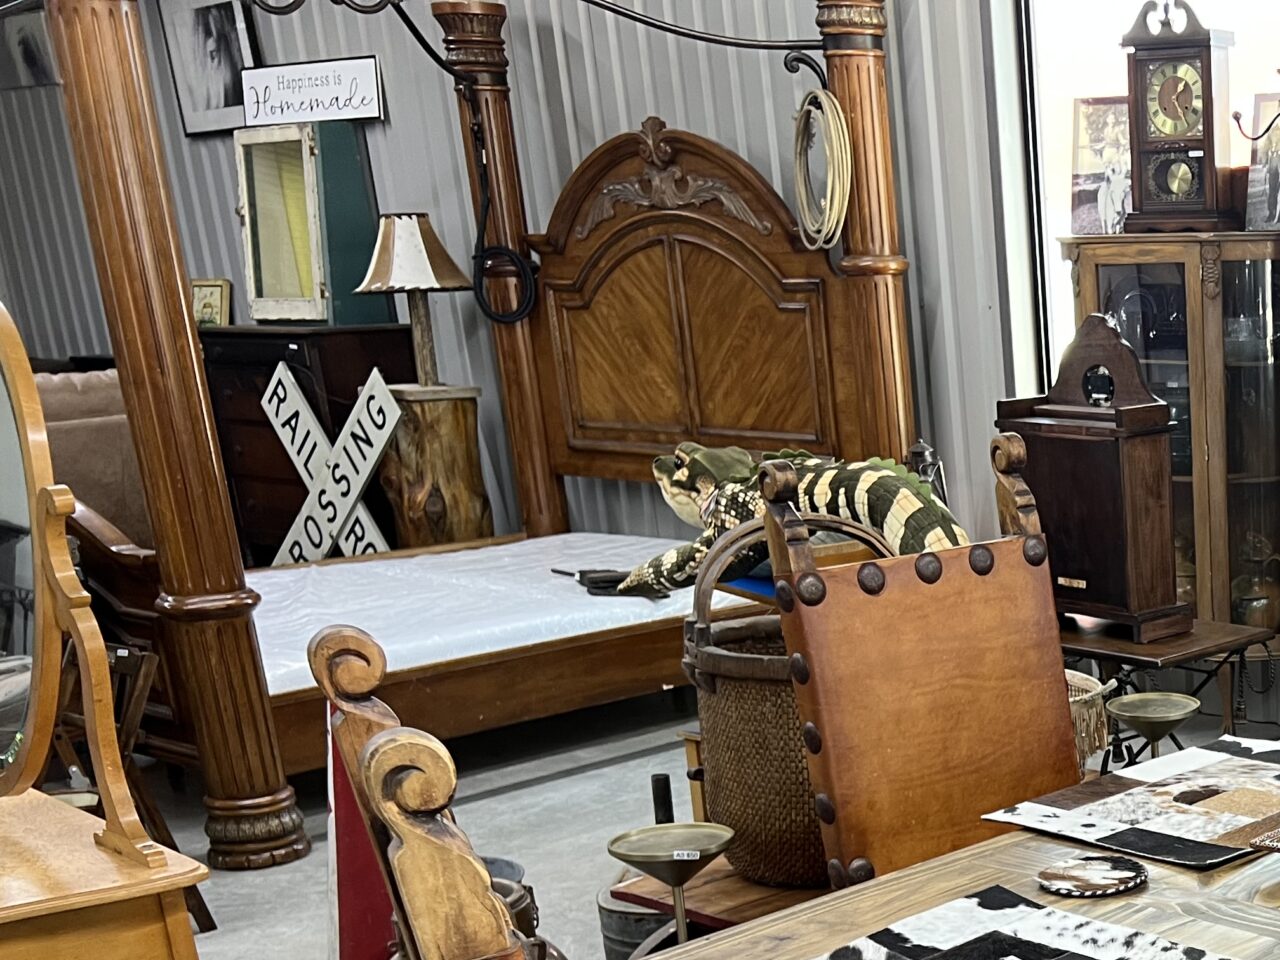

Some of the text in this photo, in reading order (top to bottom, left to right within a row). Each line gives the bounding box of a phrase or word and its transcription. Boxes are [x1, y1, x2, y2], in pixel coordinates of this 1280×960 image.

[249, 77, 374, 119] Homemade
[277, 70, 342, 95] Happiness is
[268, 377, 318, 481] RAIL
[288, 394, 387, 563] ROSSING
